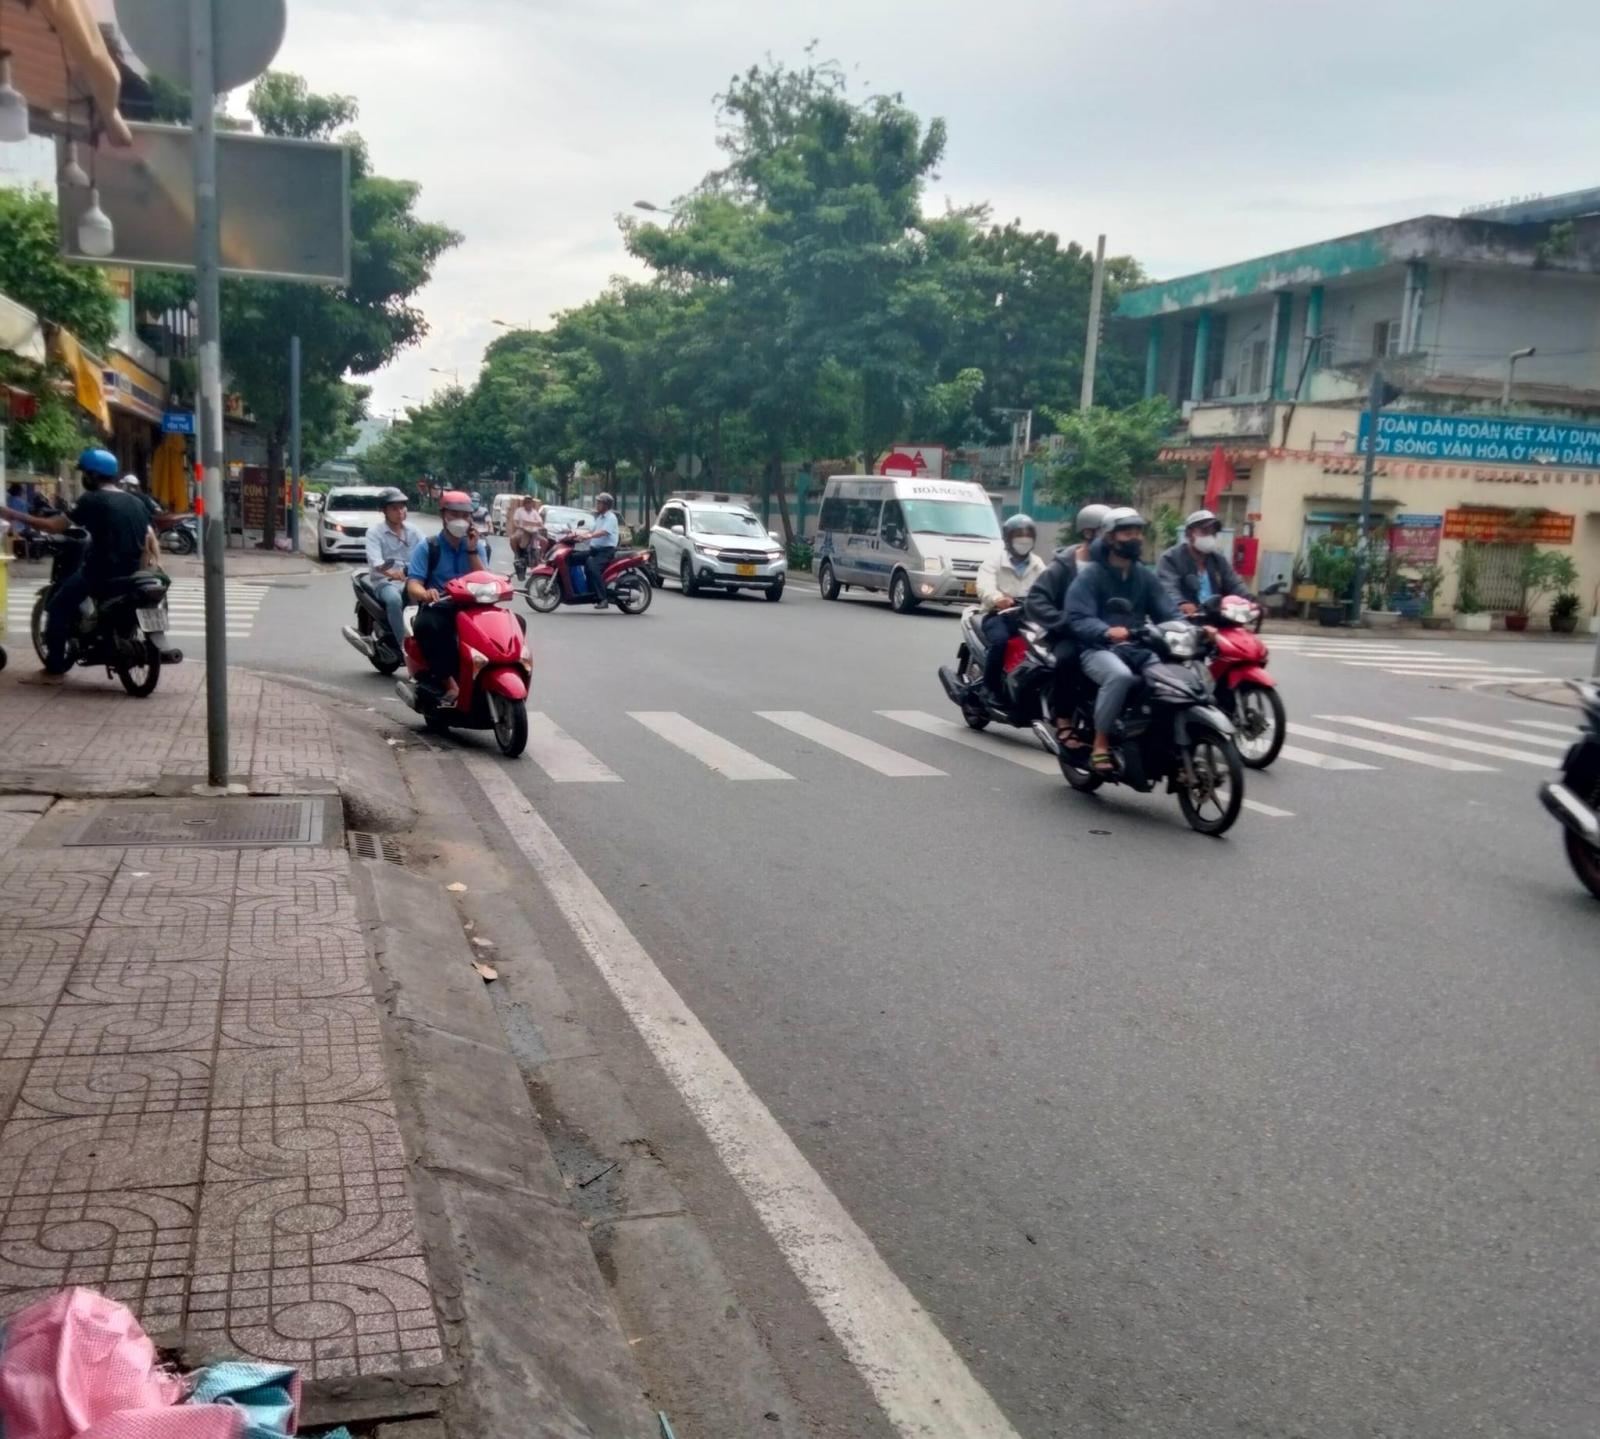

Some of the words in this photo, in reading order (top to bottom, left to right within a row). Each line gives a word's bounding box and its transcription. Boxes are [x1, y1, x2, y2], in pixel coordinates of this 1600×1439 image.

[1377, 416, 1418, 434] TOÀN
[1422, 418, 1453, 436] DÂN
[1457, 421, 1501, 439] ĐOÀN
[1536, 425, 1567, 443] XÂY
[1394, 437, 1438, 454] SỐNG
[1442, 439, 1472, 457] VĂN
[1476, 442, 1509, 459] HÓA
[1562, 446, 1594, 465] DÂN
